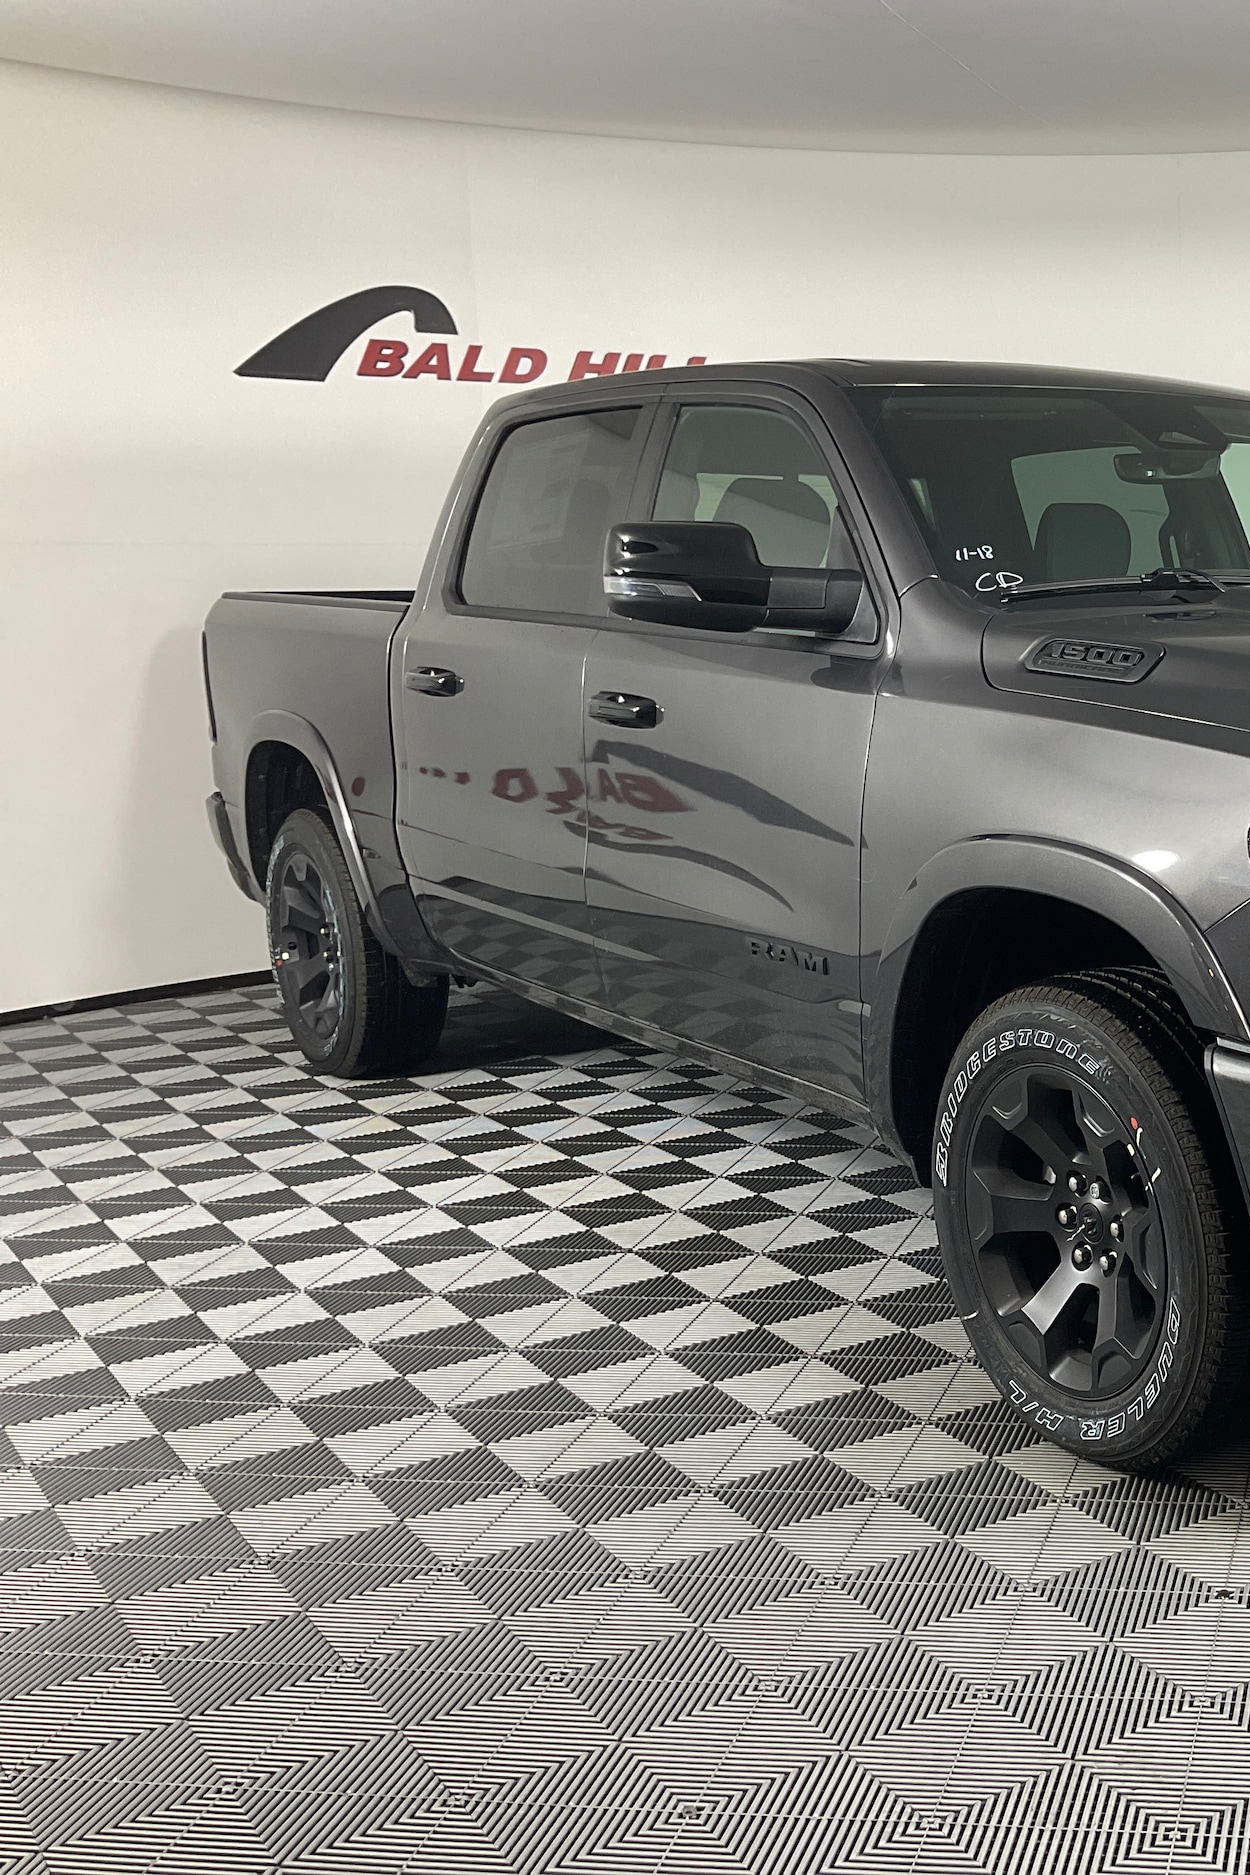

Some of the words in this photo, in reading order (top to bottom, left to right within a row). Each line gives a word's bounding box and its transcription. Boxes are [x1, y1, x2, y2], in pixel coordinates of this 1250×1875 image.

[356, 339, 547, 383] BALD
[567, 351, 706, 382] HI
[955, 545, 994, 561] 11-18
[1051, 641, 1141, 666] 1500
[745, 936, 829, 975] RAM
[936, 1029, 1099, 1187] BRIDGESTONE
[1080, 1297, 1180, 1440] DUELER
[1009, 1380, 1064, 1431] H/L
